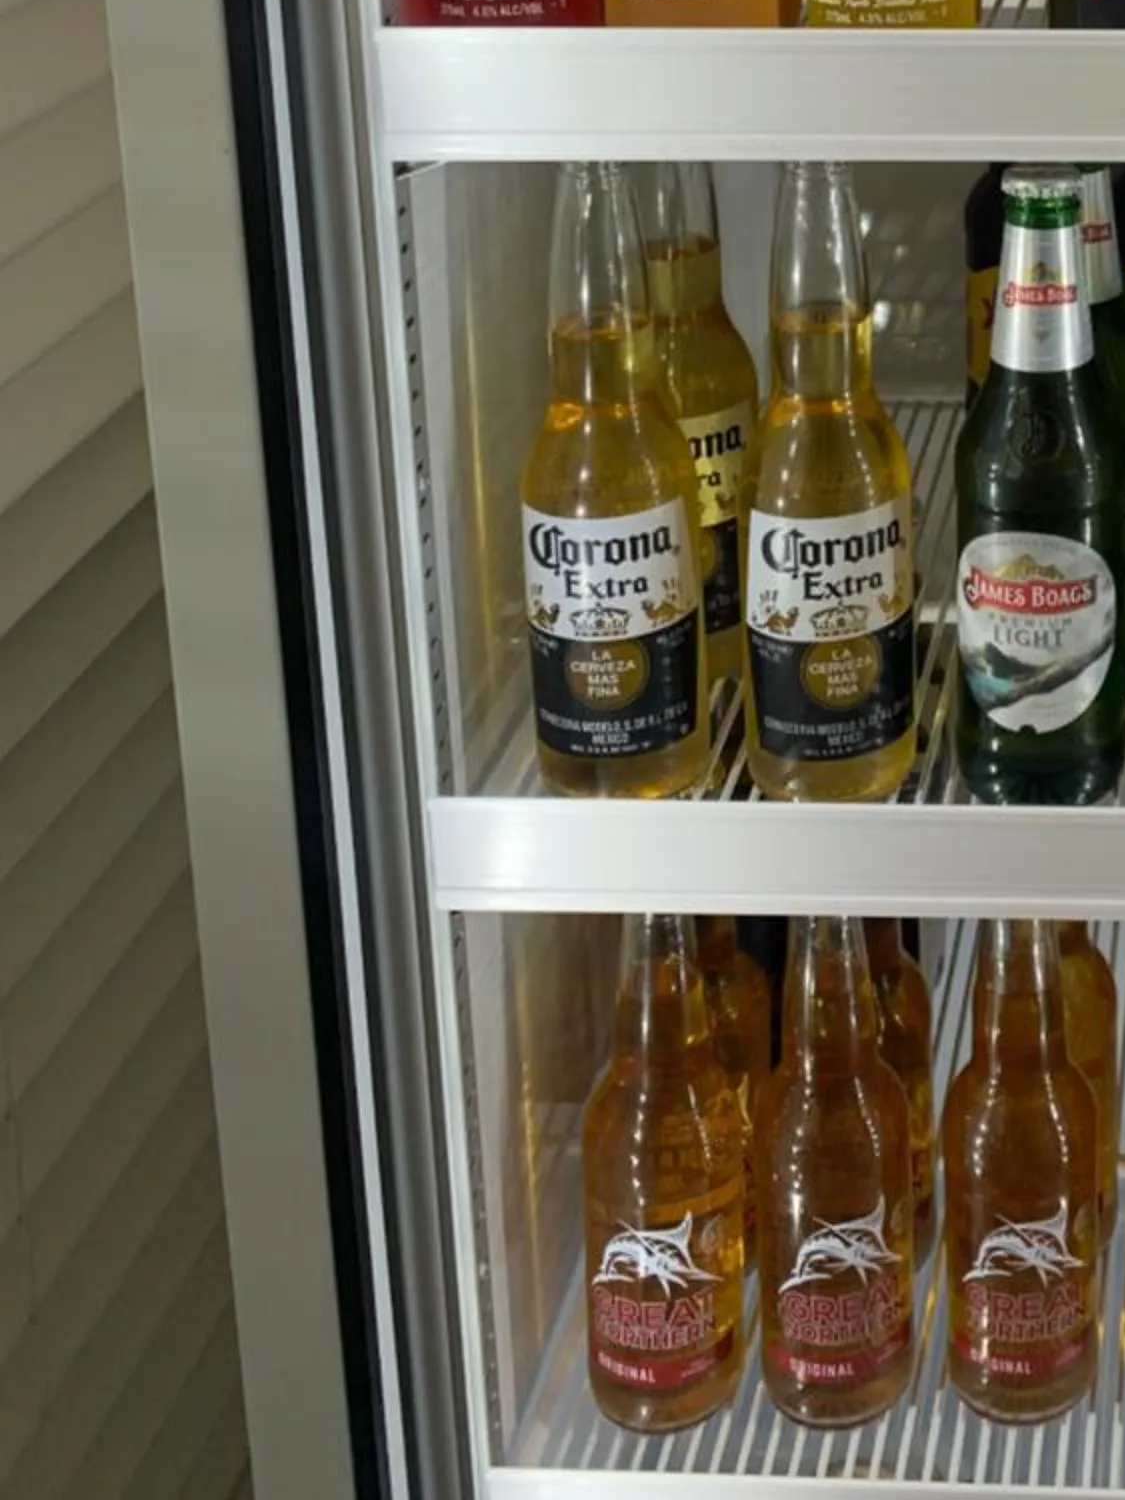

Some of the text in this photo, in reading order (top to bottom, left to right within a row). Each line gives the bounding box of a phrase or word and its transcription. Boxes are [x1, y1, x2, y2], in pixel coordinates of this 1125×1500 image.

[529, 522, 675, 577] Corona
[761, 519, 902, 580] Corona
[563, 569, 649, 600] Extra
[802, 570, 884, 601] Extra
[967, 572, 1026, 608] JAMES
[993, 624, 1064, 648] LIGHT
[569, 660, 637, 674] CERVEZA
[591, 650, 612, 662] LA
[831, 648, 851, 661] LA
[598, 1350, 657, 1384] ORIGINAL
